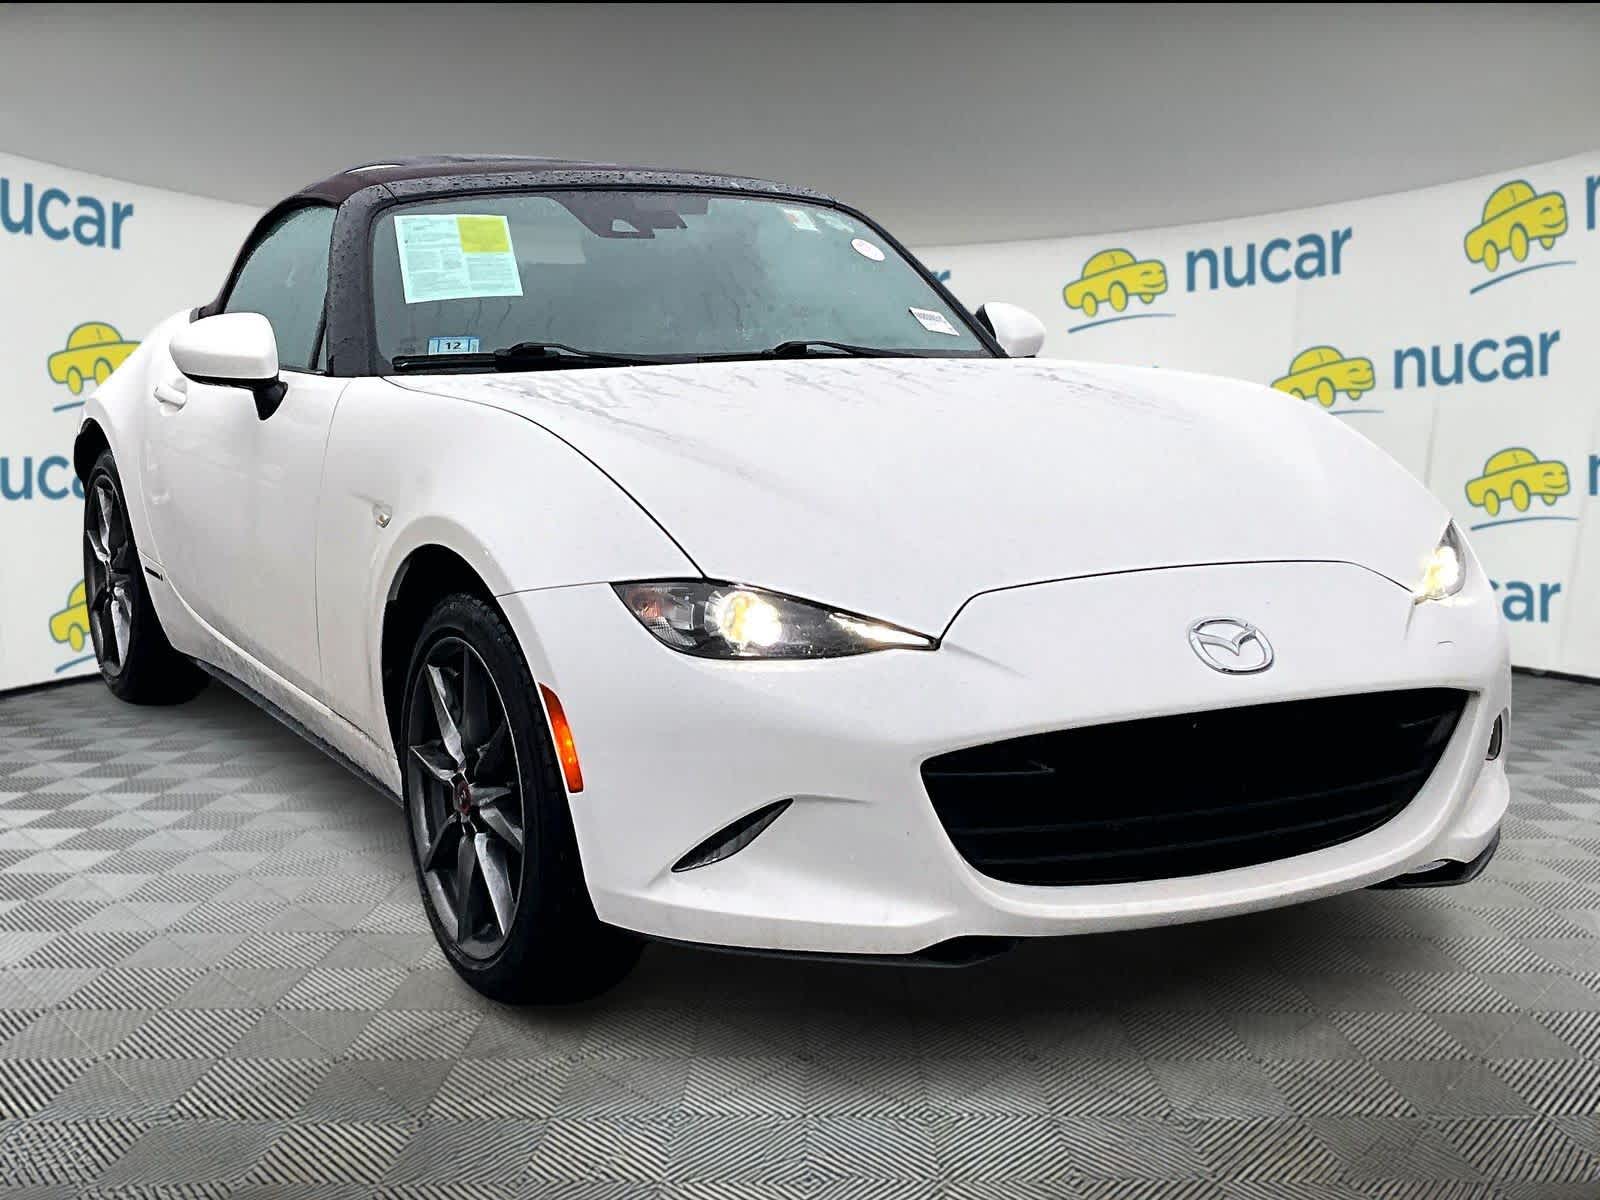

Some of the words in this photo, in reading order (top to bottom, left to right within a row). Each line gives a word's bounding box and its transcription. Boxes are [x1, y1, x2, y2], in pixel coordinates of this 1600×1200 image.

[1186, 226, 1352, 292] nucar
[446, 341, 462, 350] 12
[1393, 330, 1561, 389] nucar
[1489, 580, 1562, 623] ar
